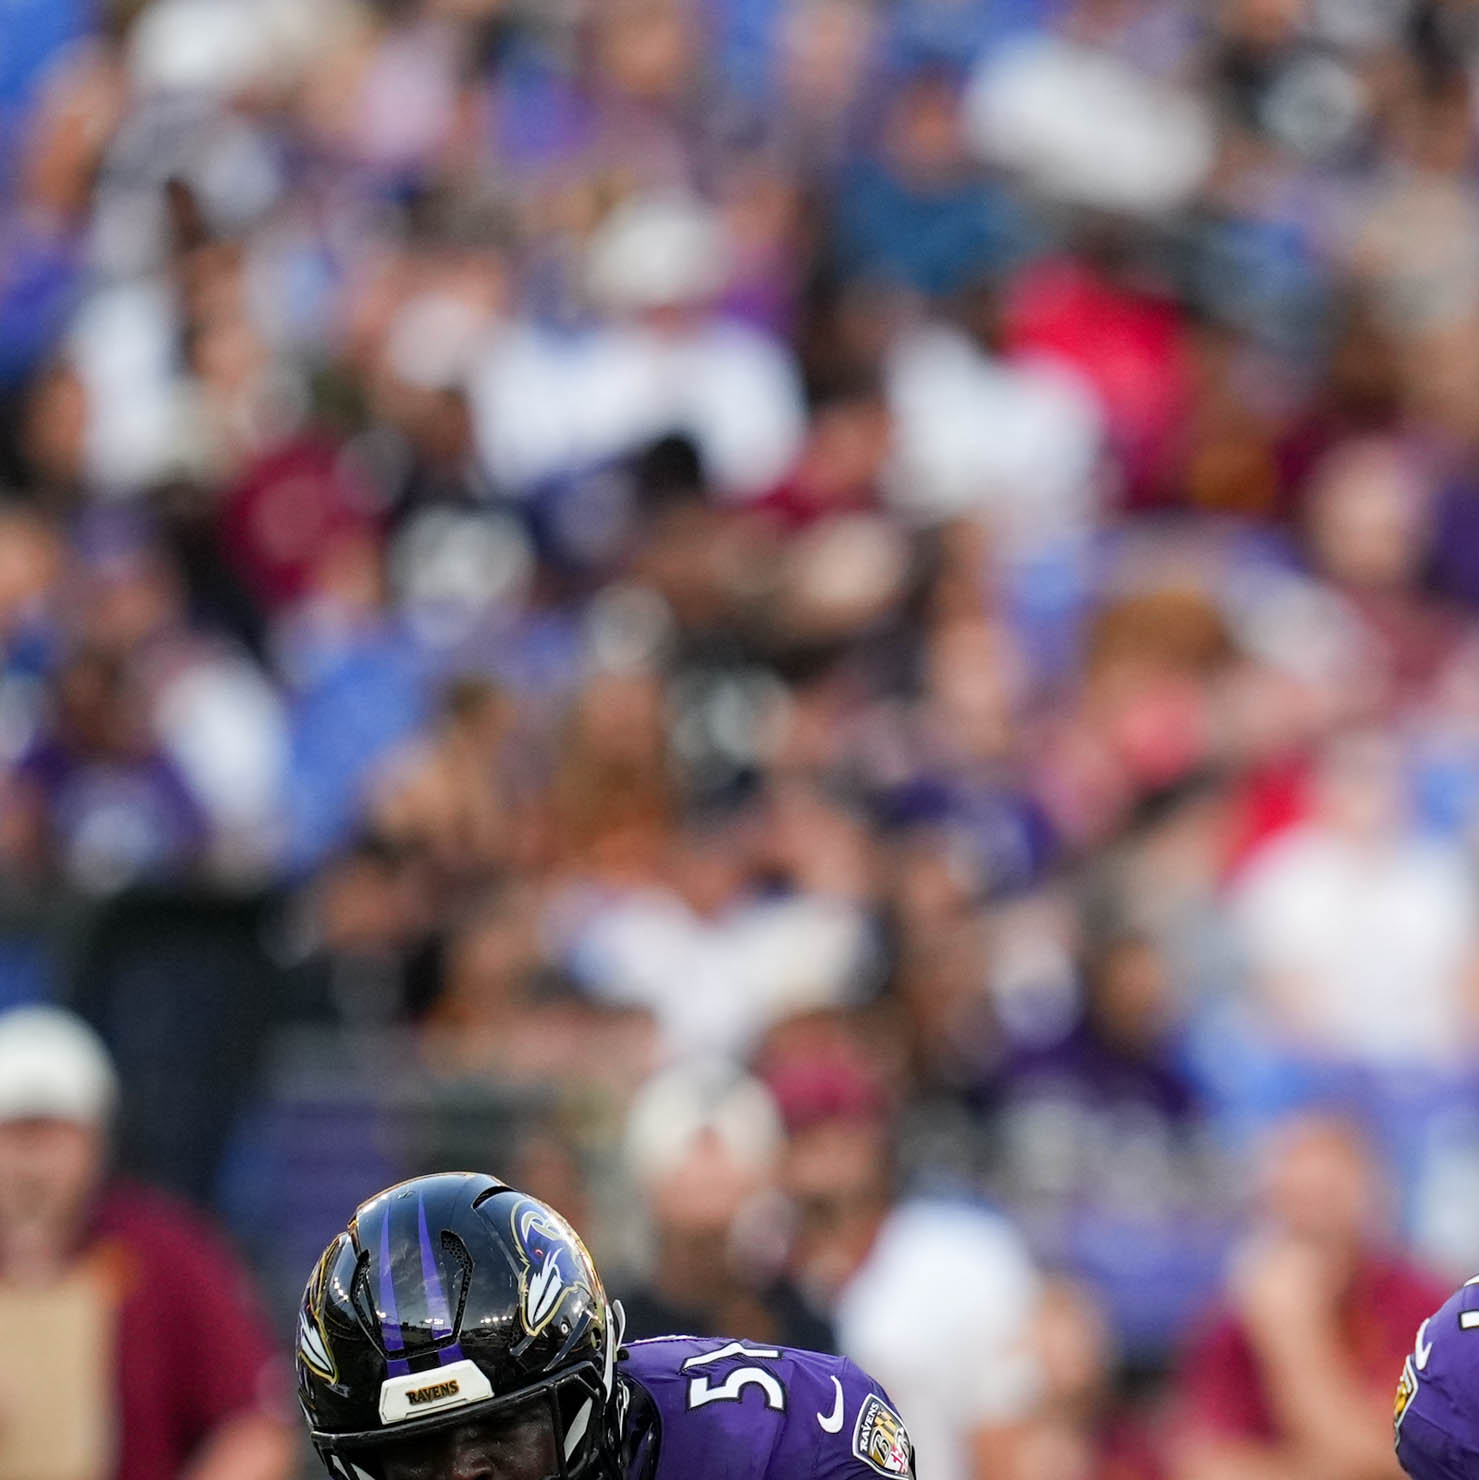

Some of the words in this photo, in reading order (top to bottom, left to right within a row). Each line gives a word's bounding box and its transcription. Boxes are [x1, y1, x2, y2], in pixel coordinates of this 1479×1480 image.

[404, 1377, 460, 1405] RAVENS
[680, 1340, 786, 1412] 51
[860, 1402, 880, 1453] RAVENS
